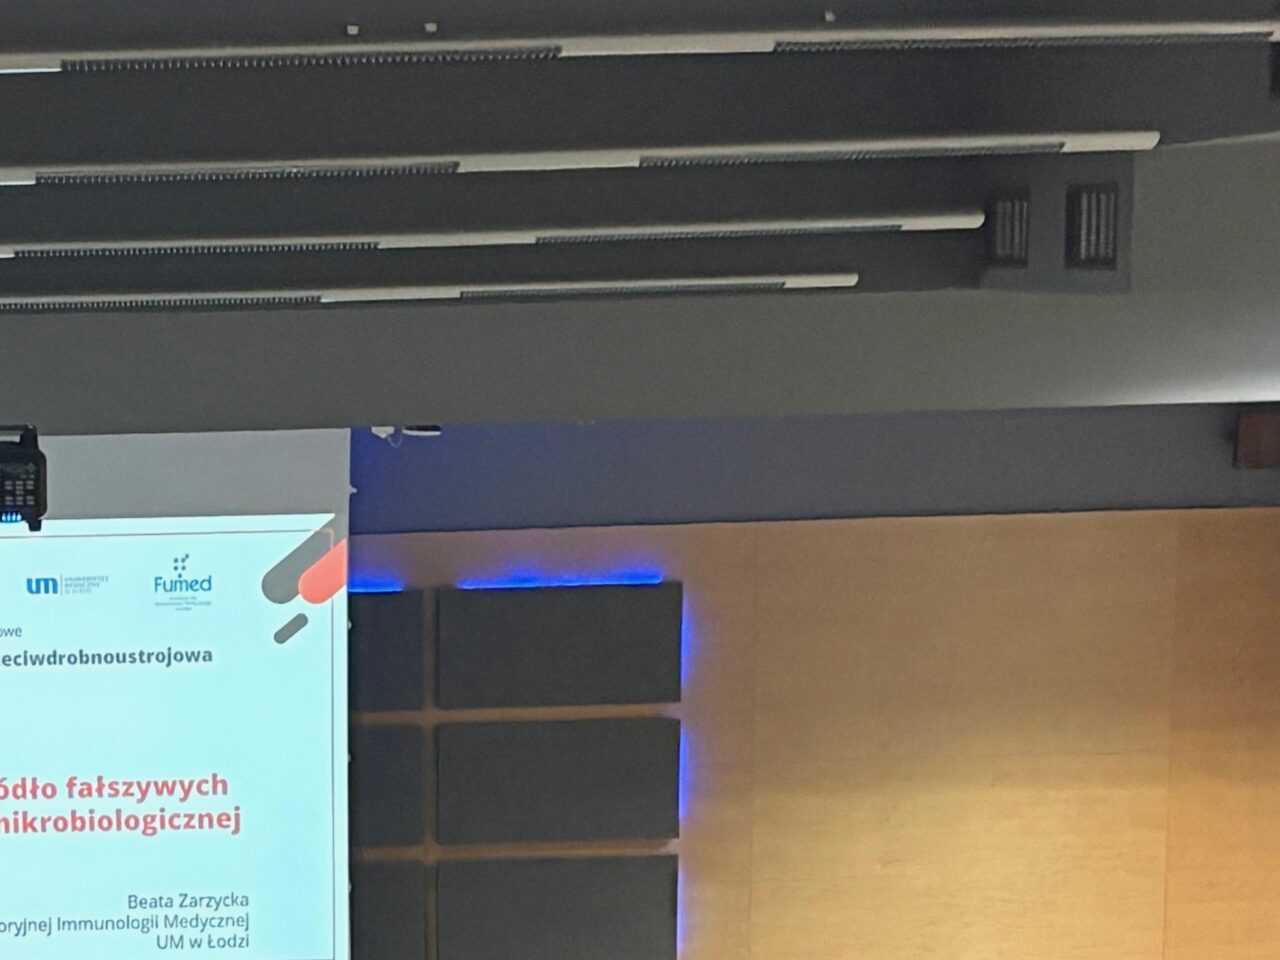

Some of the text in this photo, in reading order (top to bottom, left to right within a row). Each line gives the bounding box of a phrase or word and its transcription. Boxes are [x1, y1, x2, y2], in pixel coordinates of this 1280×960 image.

[154, 575, 212, 593] Fumed
[65, 773, 229, 804] fałszywych
[127, 892, 249, 911] Beata Zarzycka
[57, 914, 158, 934] Immunologii
[164, 912, 250, 933] Medycznej
[156, 933, 249, 950] UM w Łodzi
